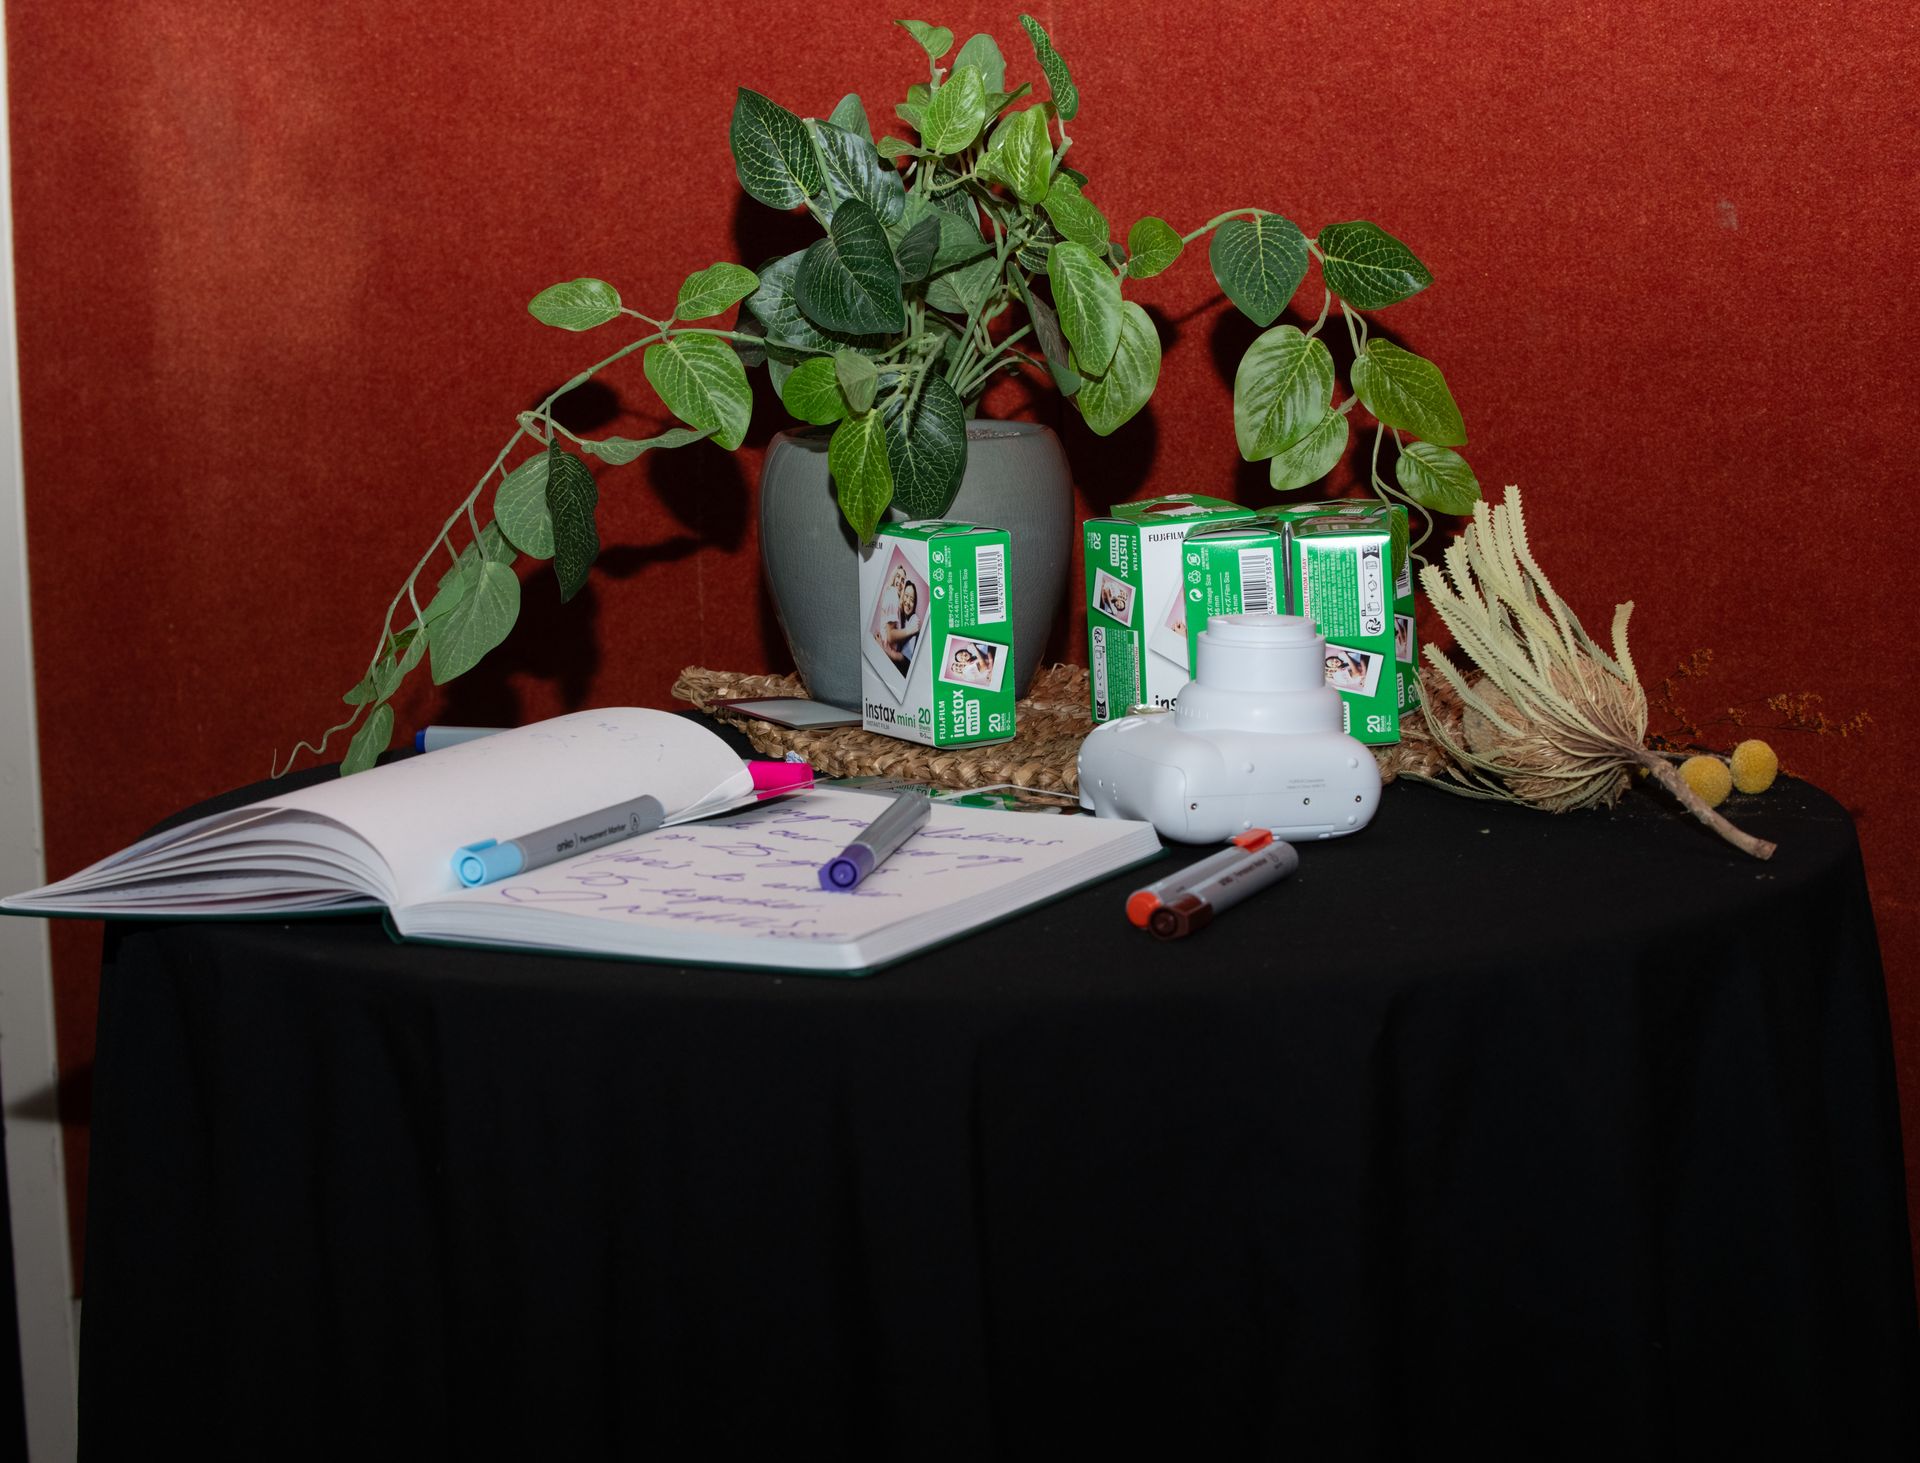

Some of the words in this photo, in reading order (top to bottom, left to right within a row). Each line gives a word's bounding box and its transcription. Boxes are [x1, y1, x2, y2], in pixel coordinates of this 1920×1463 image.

[1093, 532, 1101, 550] 20
[1120, 534, 1129, 578] instax
[1408, 684, 1415, 703] 20
[865, 698, 896, 724] instax
[896, 713, 916, 729] mini
[918, 707, 931, 725] 20
[951, 689, 965, 738] instax
[967, 702, 979, 733] mini
[988, 713, 1001, 733] 20
[1367, 715, 1380, 733] 20
